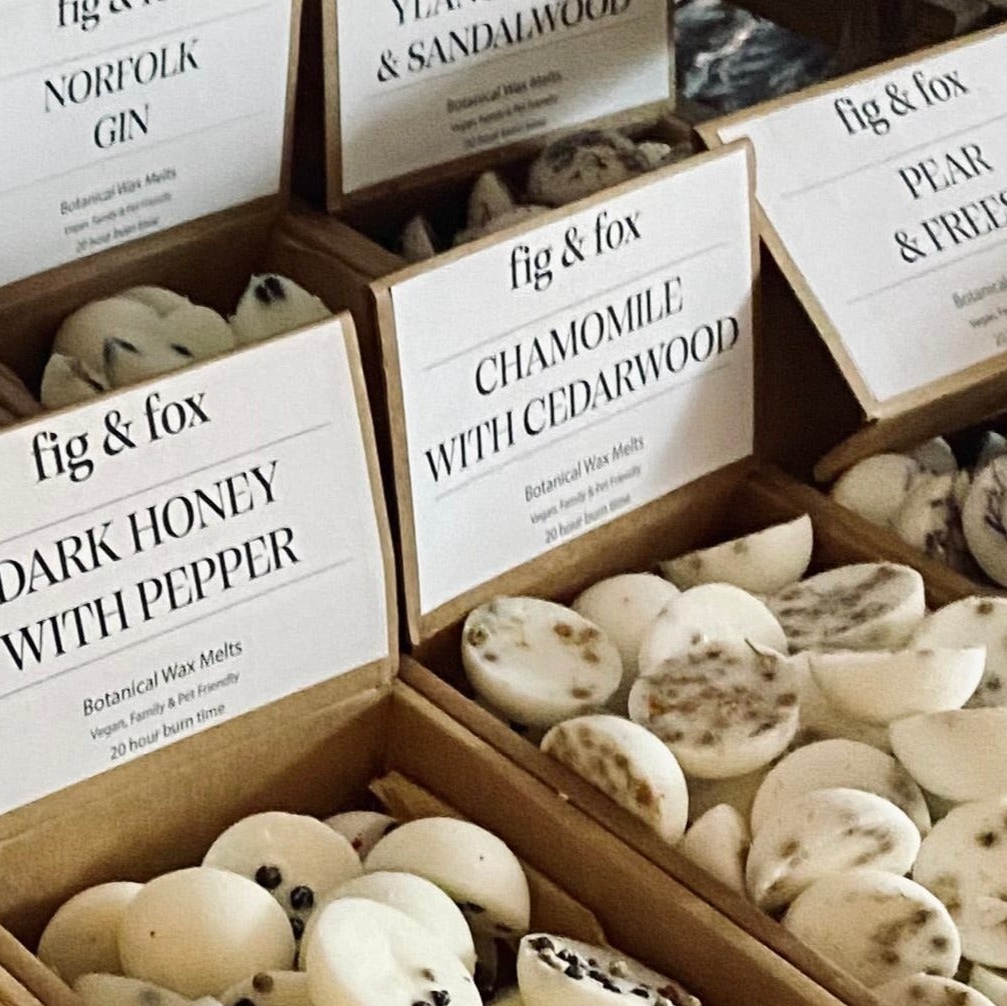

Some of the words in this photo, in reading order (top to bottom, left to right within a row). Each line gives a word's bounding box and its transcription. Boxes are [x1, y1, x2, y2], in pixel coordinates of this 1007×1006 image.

[44, 39, 200, 112] NORFOLK
[377, 49, 400, 82] &
[407, 0, 632, 73] SANDALWOOD
[94, 104, 149, 150] GIN
[833, 97, 890, 136] fig
[885, 79, 918, 118] &
[912, 69, 971, 107] fox
[898, 143, 994, 199] PEAR
[509, 244, 553, 291] fig
[562, 226, 586, 269] &
[594, 209, 642, 257] fox
[894, 229, 927, 264] &
[475, 275, 684, 397] CHAMOMILE
[424, 410, 516, 483] WITH
[523, 315, 740, 437] CEDARWOOD
[30, 430, 95, 485] fig
[102, 408, 136, 457] &
[145, 390, 211, 443] fox
[525, 460, 581, 503] Botanical
[584, 453, 610, 475] Wax
[612, 435, 644, 461] Melts
[127, 460, 279, 553] HONEY
[0, 590, 129, 673] WITH
[136, 525, 300, 622] PEPPER
[83, 670, 159, 717] Botanical
[161, 660, 196, 684] Wax
[200, 641, 243, 670] Melts
[90, 719, 128, 741] Vegan,
[130, 702, 166, 727] Family
[167, 697, 176, 709] &
[178, 689, 196, 706] Pet
[197, 672, 240, 698] Friendly
[110, 743, 127, 761] 20
[129, 730, 160, 752] hour
[163, 716, 194, 738] burn
[196, 703, 226, 724] time
